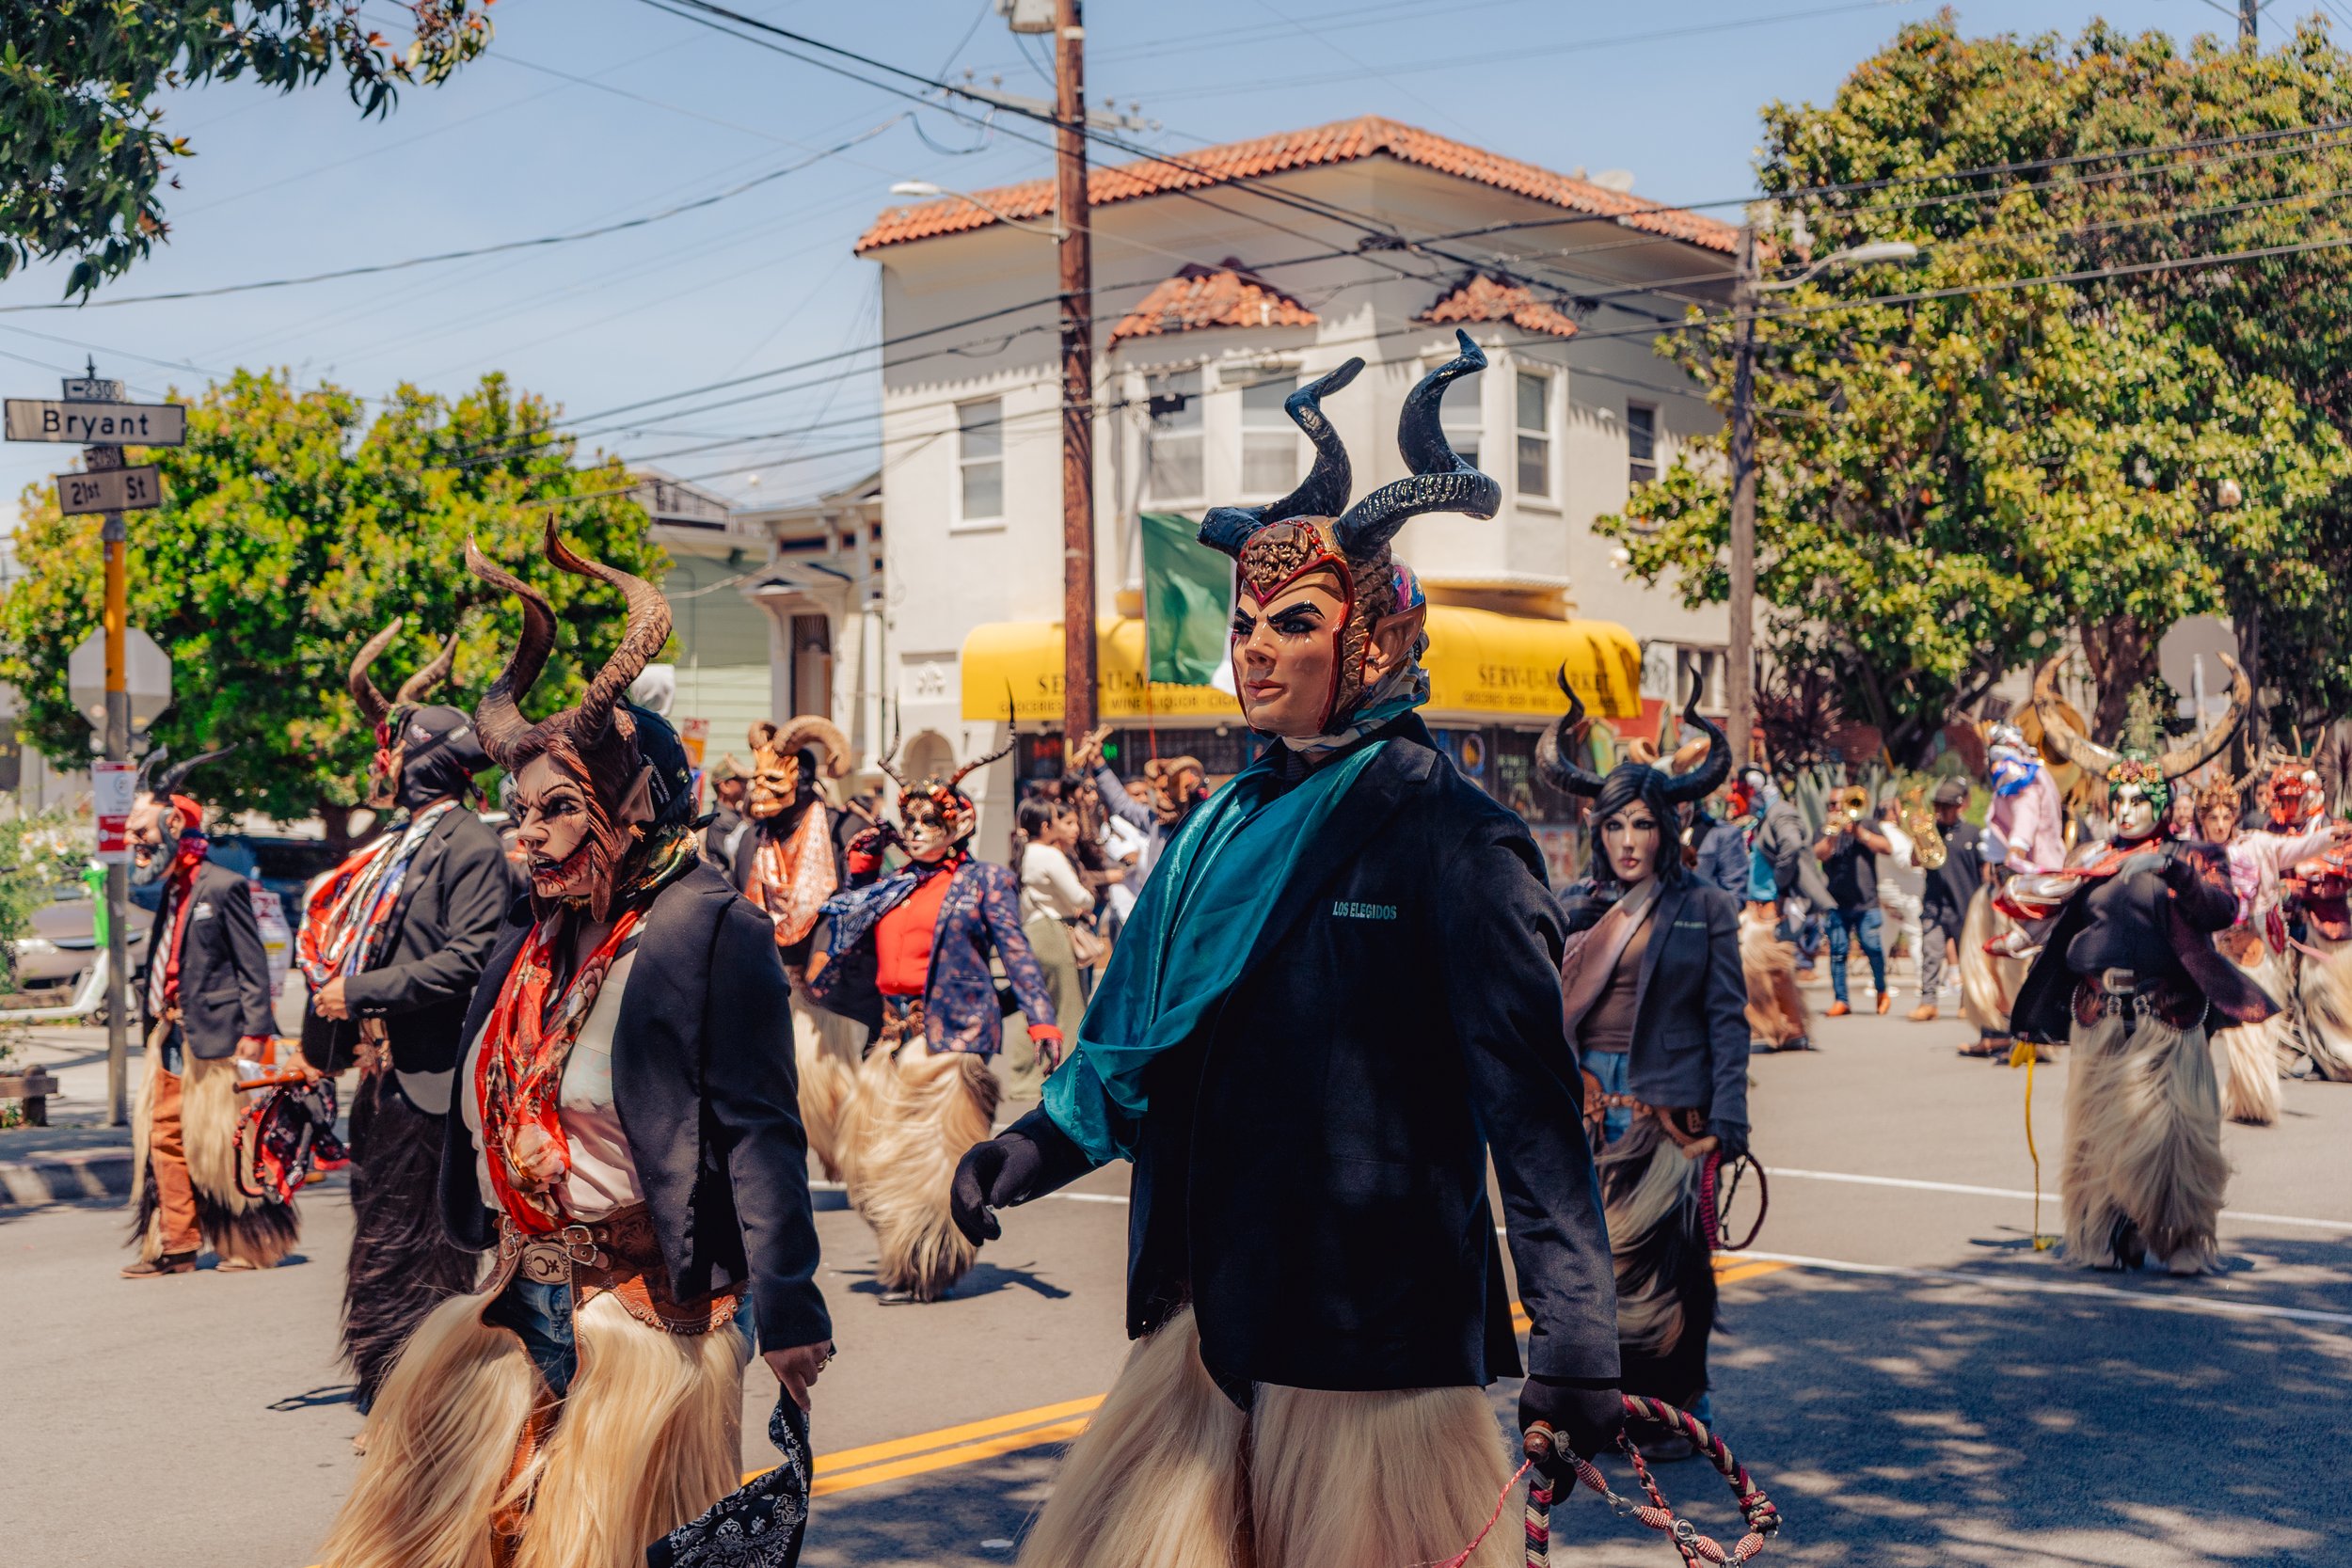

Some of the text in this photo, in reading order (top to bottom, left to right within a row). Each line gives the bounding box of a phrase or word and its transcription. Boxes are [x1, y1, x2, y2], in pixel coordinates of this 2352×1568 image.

[43, 410, 149, 439] Bryant
[71, 476, 146, 506] 21st St
[1478, 663, 1612, 692] SERV-U-MRKET
[1000, 699, 1065, 713] GOCERIES
[1112, 697, 1140, 710] WINE
[1332, 901, 1397, 919] LOS ELEGIDOS
